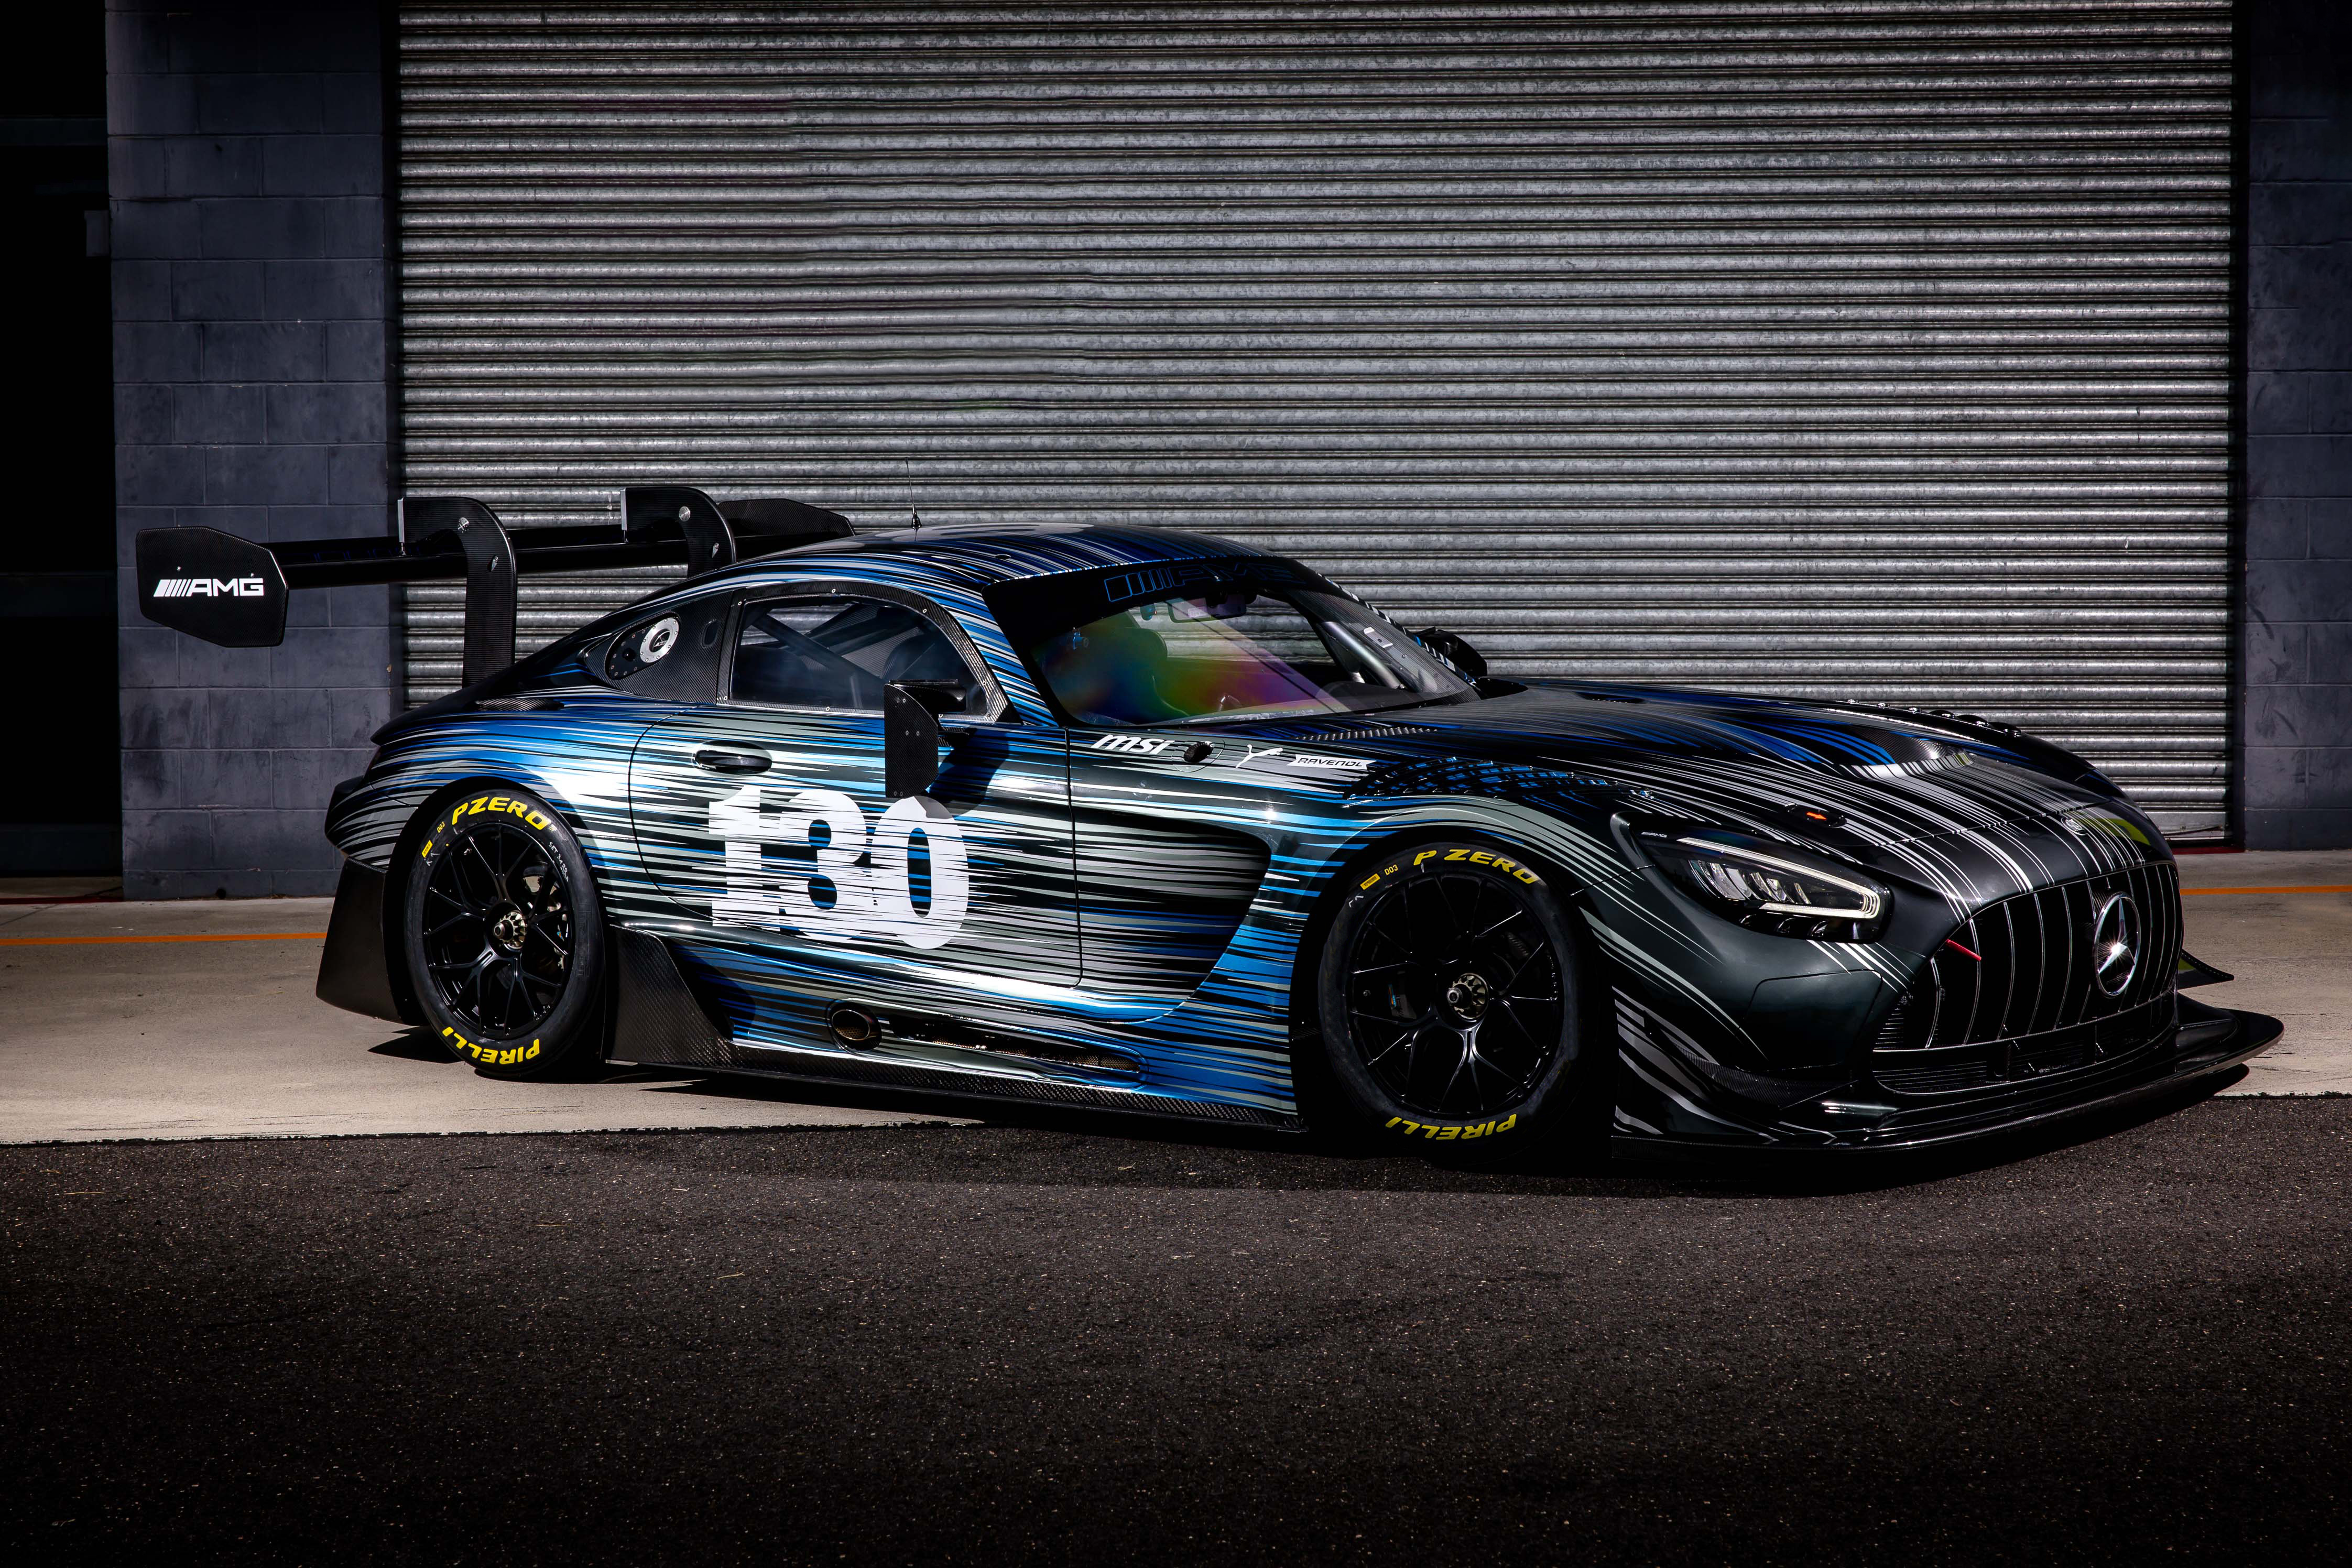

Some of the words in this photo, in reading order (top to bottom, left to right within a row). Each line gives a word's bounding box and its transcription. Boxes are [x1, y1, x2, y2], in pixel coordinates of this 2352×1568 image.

[186, 578, 264, 596] AMG
[1298, 758, 1363, 767] RAVENOL
[709, 784, 970, 950] 130
[442, 1027, 540, 1065] PIRELLI
[1385, 1114, 1518, 1140] PIRELLI
